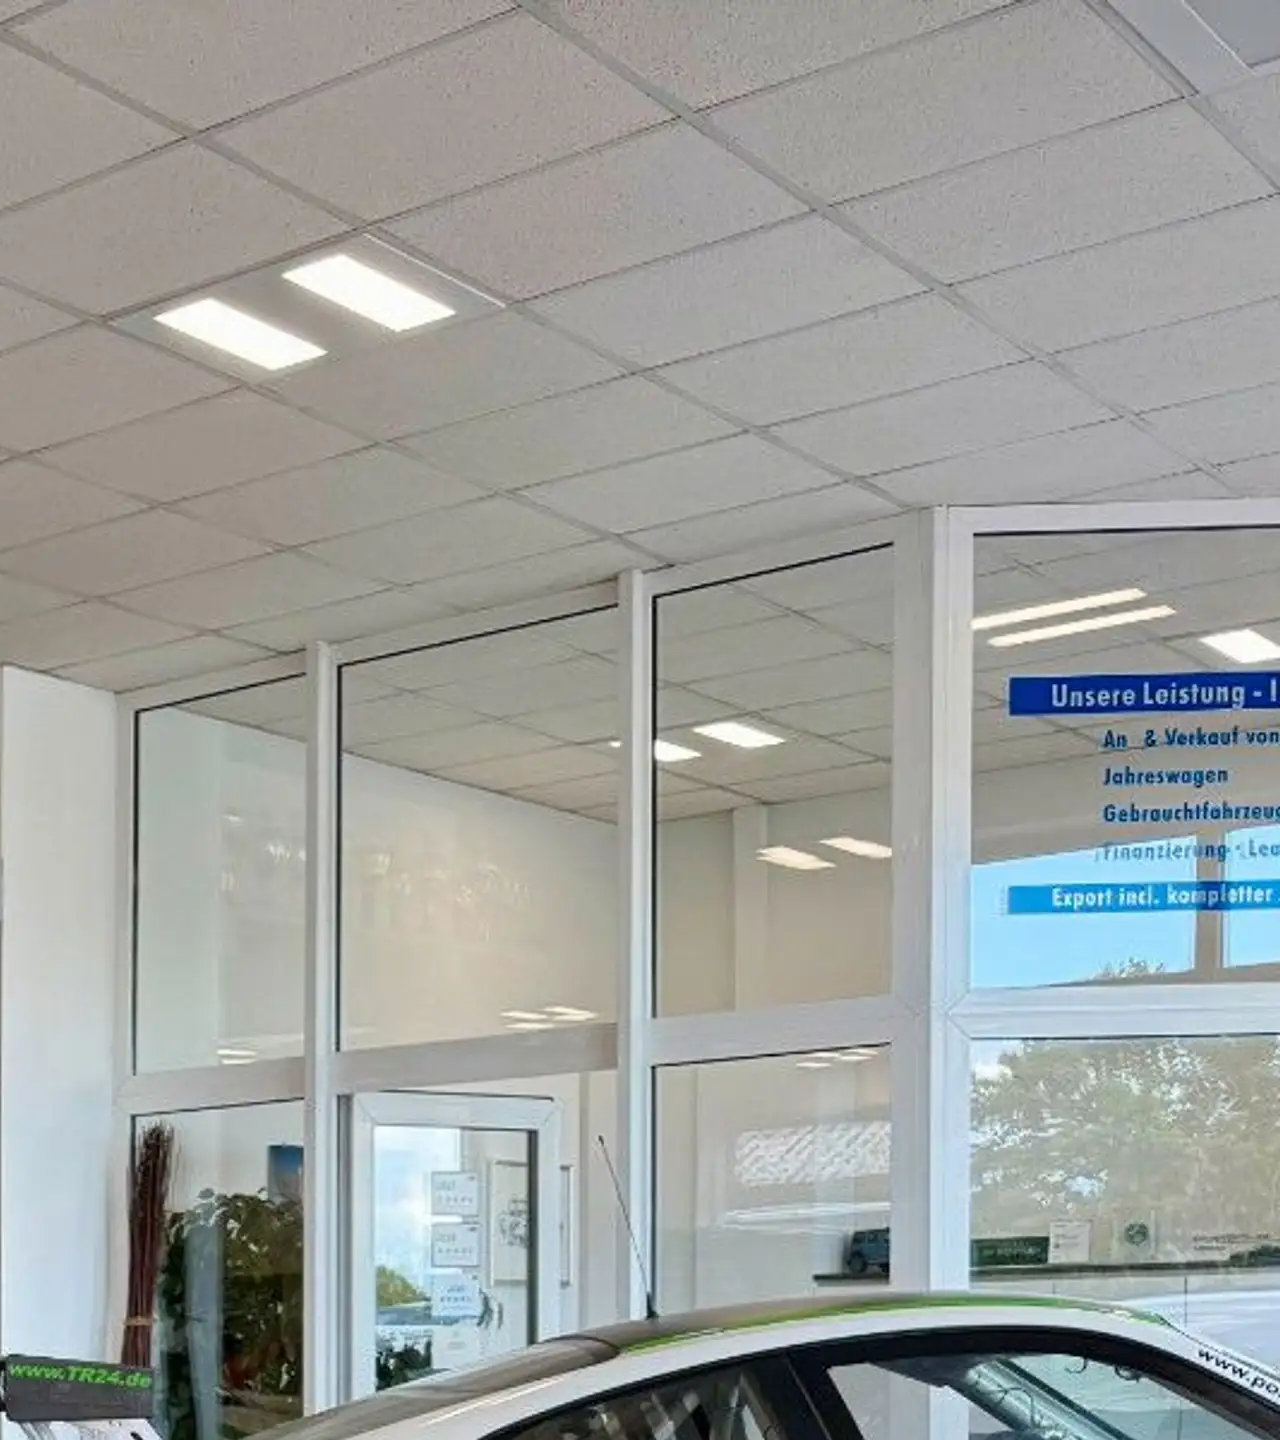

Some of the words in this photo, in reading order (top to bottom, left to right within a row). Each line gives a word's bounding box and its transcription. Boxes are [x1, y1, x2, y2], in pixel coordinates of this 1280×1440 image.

[1052, 684, 1135, 707] Unsere
[1143, 681, 1245, 709] Leistung
[1102, 729, 1128, 748] An
[1144, 729, 1158, 748] &
[1165, 725, 1240, 746] Verkauf
[1246, 730, 1280, 746] von
[1103, 766, 1229, 788] Jahreswagen
[1052, 887, 1113, 910] Export
[1119, 884, 1159, 907] incl.
[1167, 882, 1273, 907] kompletter
[10, 1364, 152, 1388] www.TR24.de
[1198, 1349, 1280, 1398] www.po
